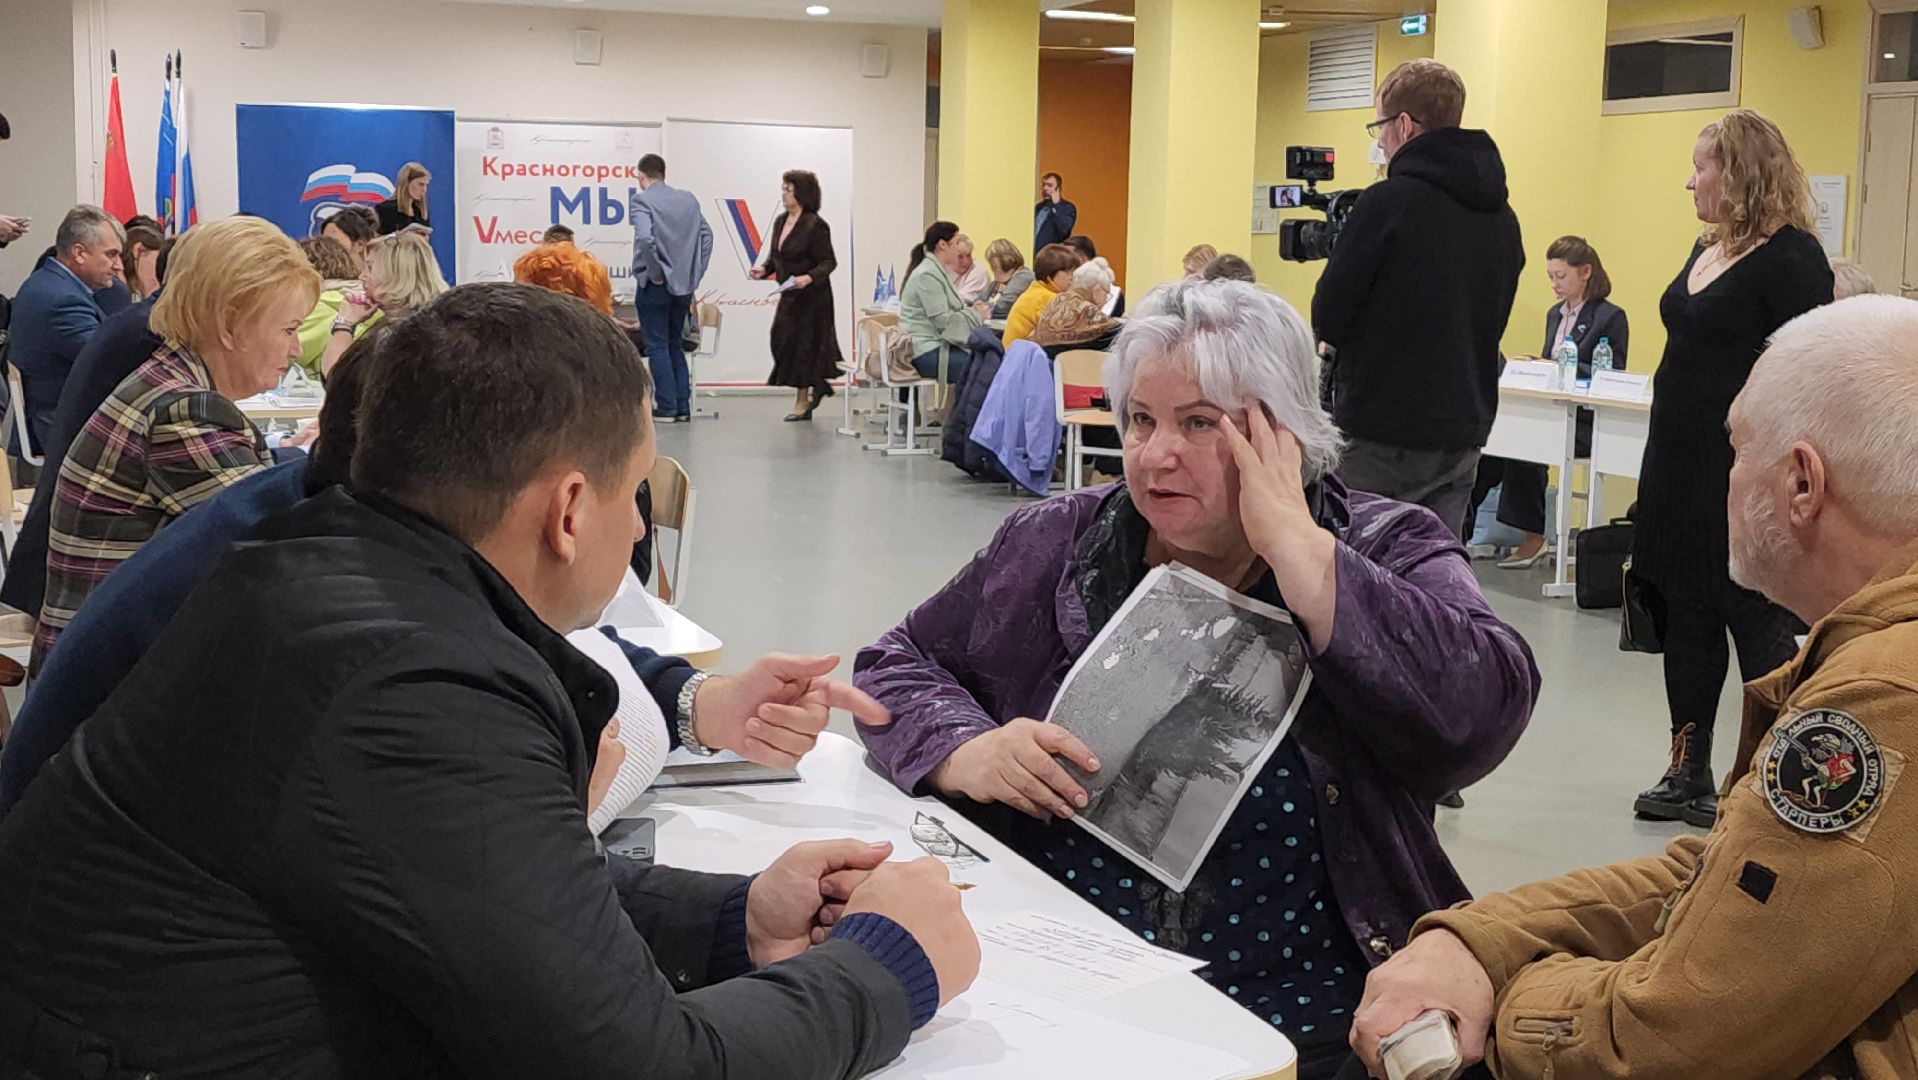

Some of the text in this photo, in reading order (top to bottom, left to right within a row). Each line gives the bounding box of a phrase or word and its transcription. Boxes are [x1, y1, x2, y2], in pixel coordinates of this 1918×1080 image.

[550, 186, 637, 226] МЫ
[1772, 713, 1879, 797] ОТДЛЬНЫЙ СВОДНЫЙ ОТРЯД
[1770, 788, 1845, 828] СТАРПЕРЫ
